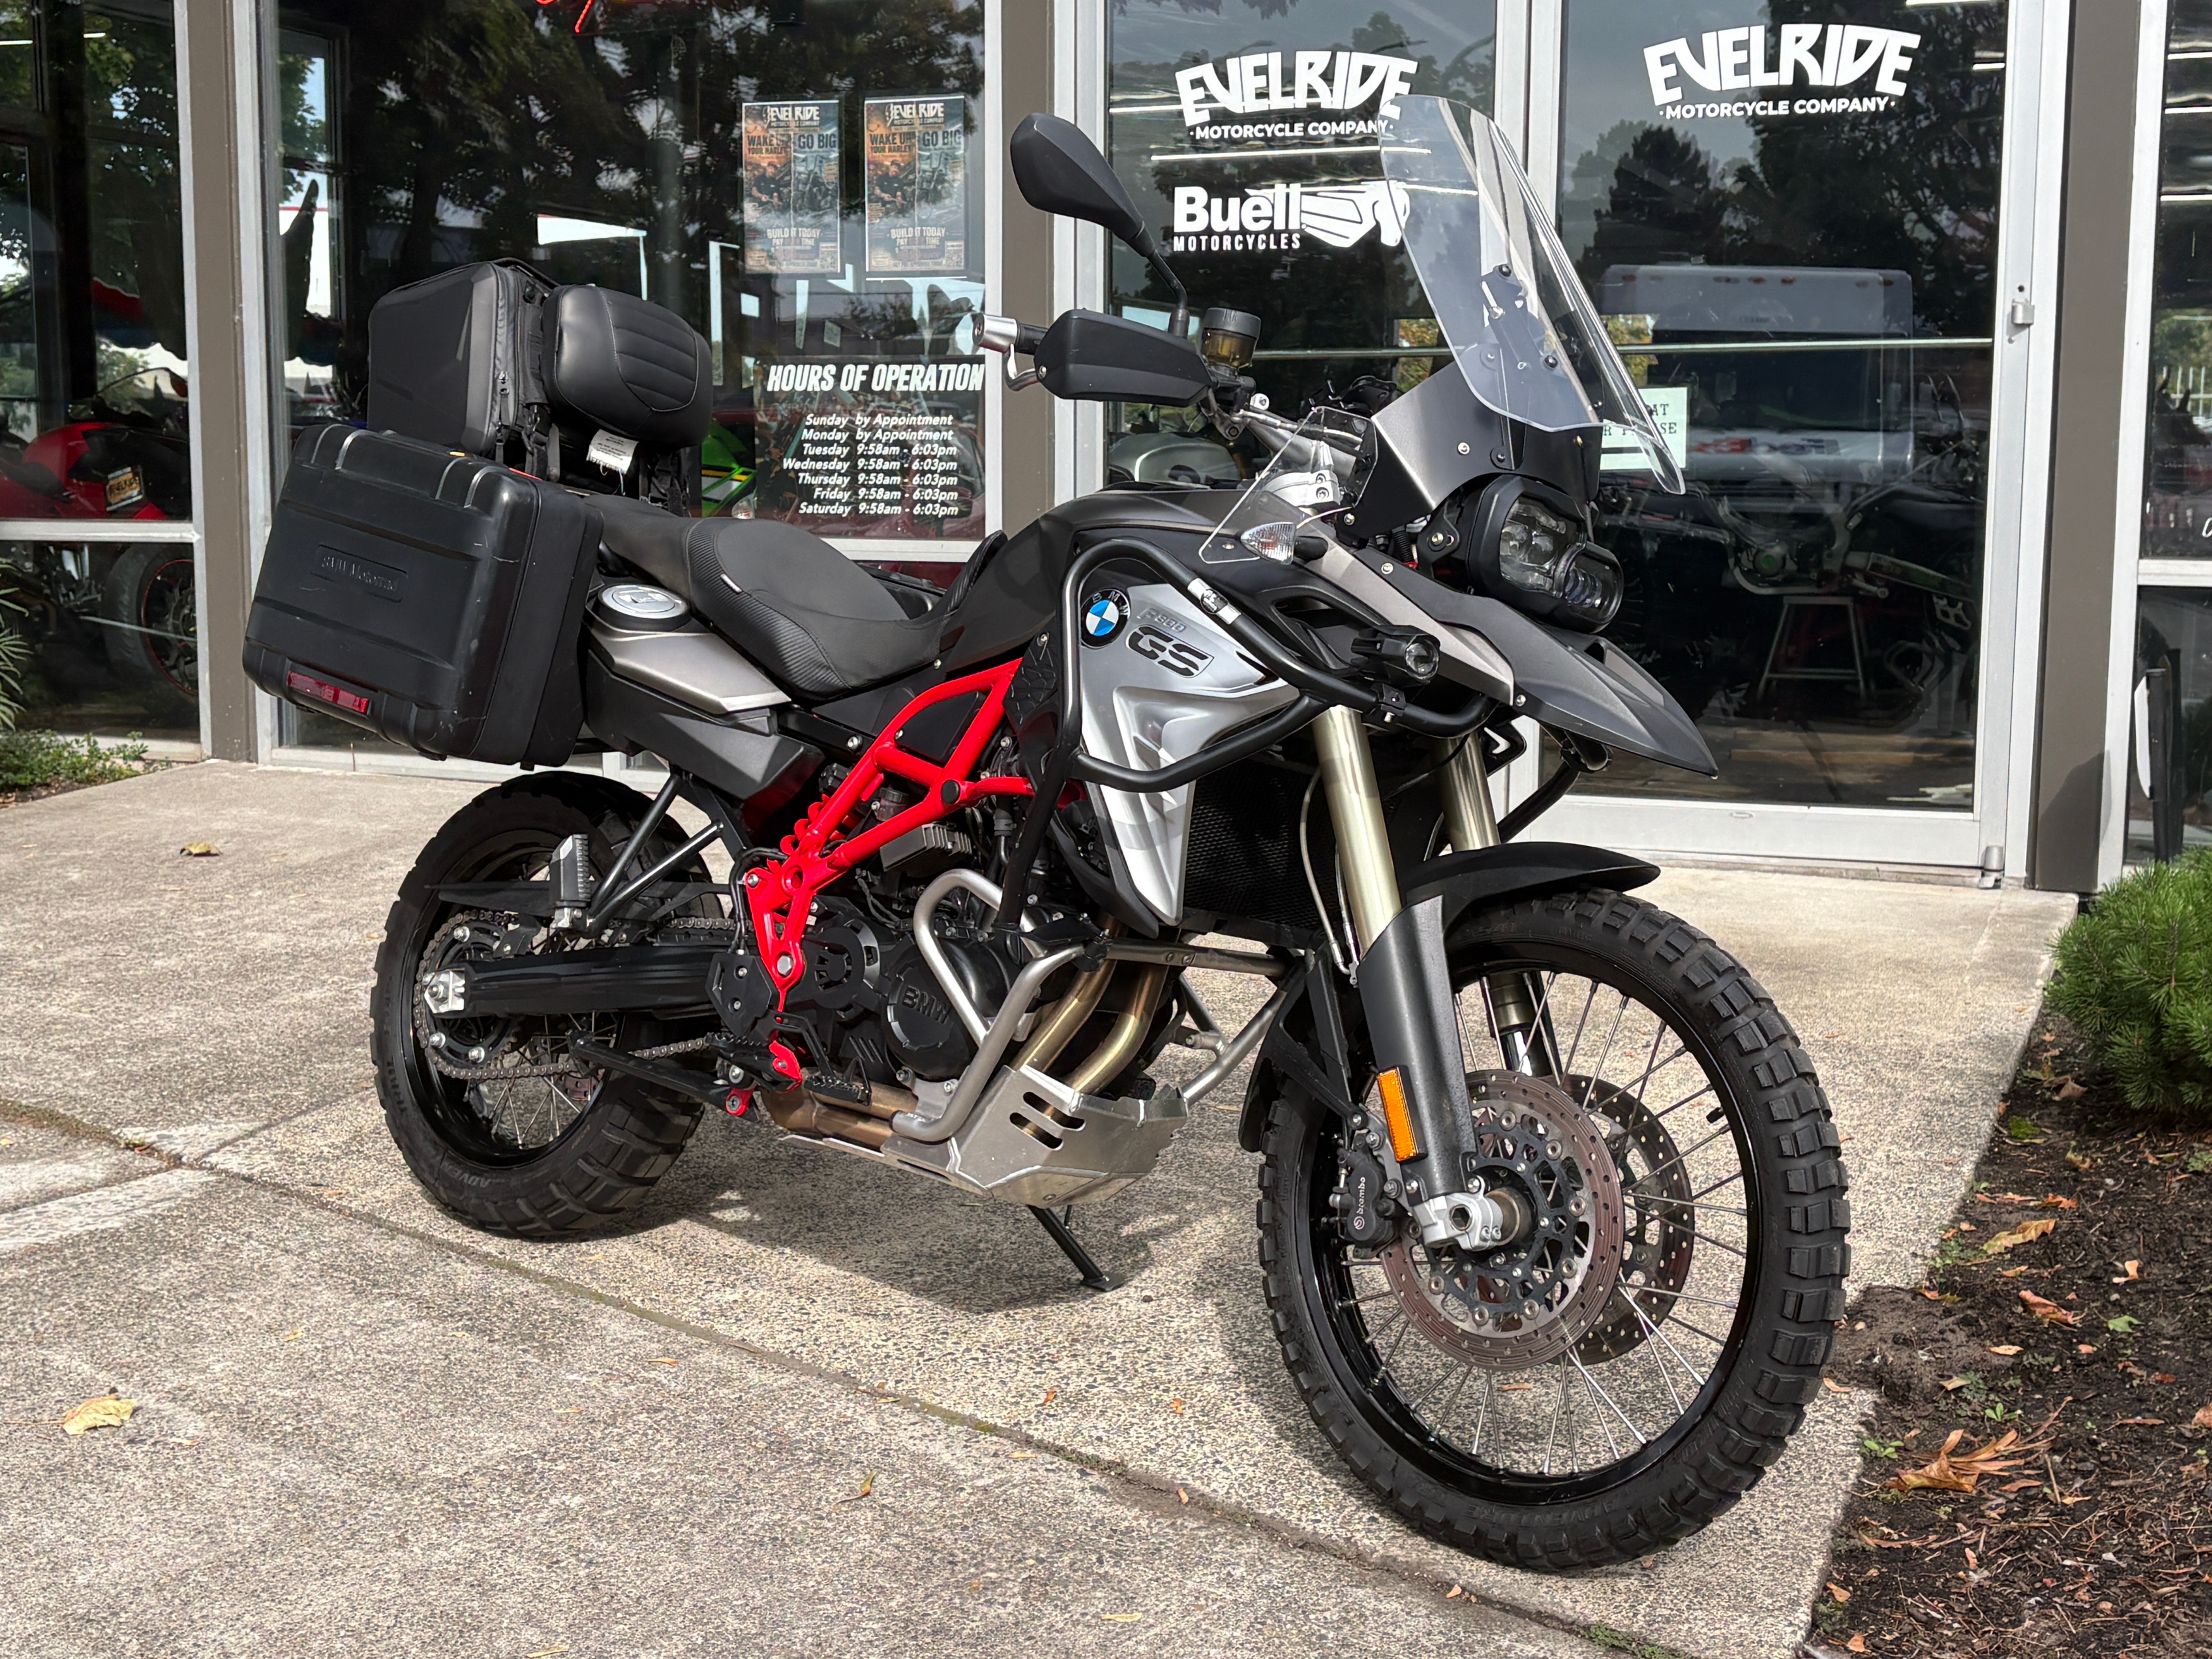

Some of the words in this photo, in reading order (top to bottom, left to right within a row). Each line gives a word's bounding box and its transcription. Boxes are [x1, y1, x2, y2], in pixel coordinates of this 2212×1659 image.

[1665, 100, 1790, 120] MOTORCYCLE
[1793, 96, 1888, 115] COMPANY
[1195, 123, 1304, 139] MOTORCYCLE
[1307, 120, 1388, 135] COMPANY
[748, 135, 775, 147] WAKE
[798, 134, 814, 149] GO
[818, 134, 836, 149] BIG
[870, 133, 897, 145] WAKE
[922, 131, 938, 147] GO
[942, 129, 962, 146] BIG
[1173, 183, 1301, 233] Buell
[766, 228, 789, 239] BUILD
[791, 228, 797, 237] IT
[799, 228, 821, 237] TODAY
[891, 227, 914, 239] BUILD
[915, 227, 921, 237] IT
[923, 227, 946, 237] TODAY
[1173, 233, 1301, 252] MOTORCYCLES
[766, 364, 836, 392] HOURS
[840, 364, 870, 391] OF
[871, 364, 985, 392] OPERATION
[805, 414, 848, 428] Sunday
[855, 414, 871, 428] by
[874, 414, 953, 428] Appointment
[801, 429, 849, 443] Monday
[856, 429, 871, 443] by
[873, 429, 953, 443] Appointment
[803, 444, 850, 458] Tuesday
[857, 444, 900, 455] 9:58am
[912, 444, 957, 459] 6:03pm
[783, 459, 850, 473] Wednesday
[857, 459, 900, 470] 9:58am
[912, 459, 957, 473] 6:03pm
[798, 474, 850, 488] Thursday
[857, 474, 901, 485] 9:58am
[912, 474, 957, 488] 6:03pm
[814, 488, 851, 503] Friday
[858, 489, 901, 500] 9:58am
[913, 489, 958, 503] 6:03pm
[799, 503, 851, 518] Saturday
[858, 504, 902, 515] 9:58am
[913, 504, 958, 518] 6:03pm
[1128, 626, 1209, 677] GS
[902, 985, 951, 1024] BMW
[1356, 1176, 1366, 1214] brembo
